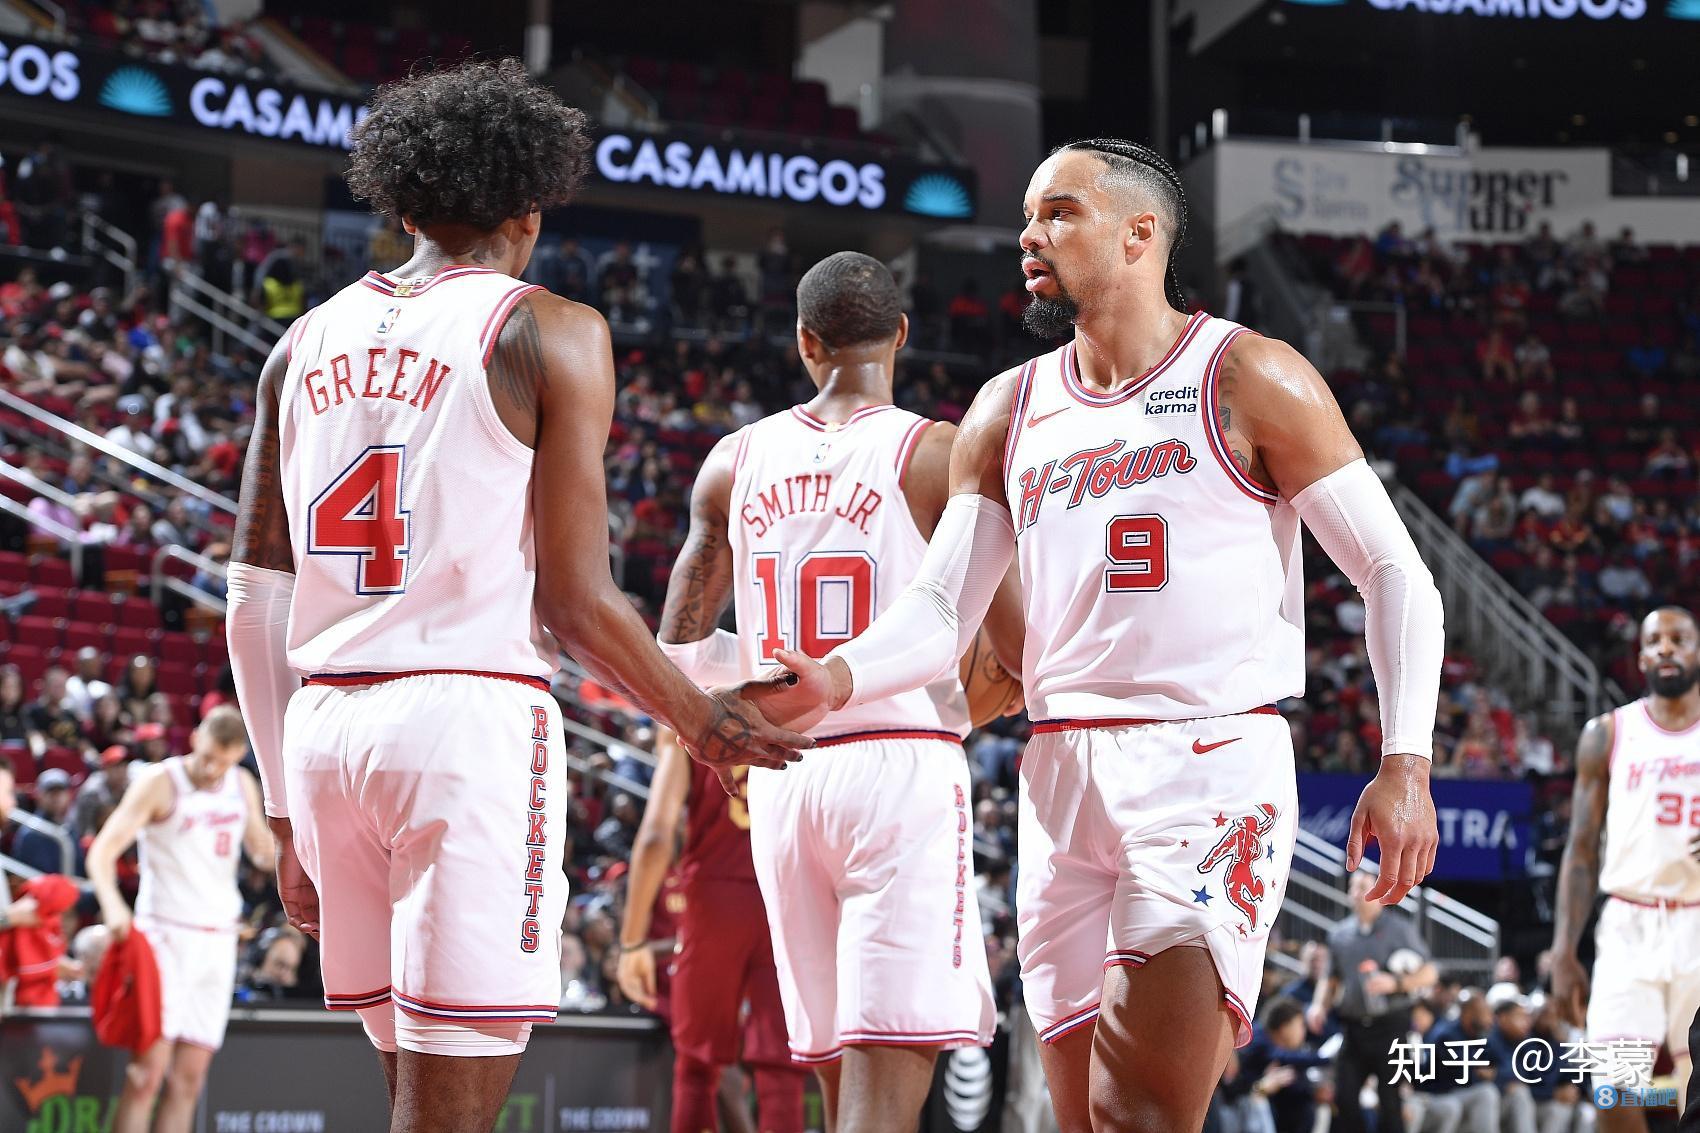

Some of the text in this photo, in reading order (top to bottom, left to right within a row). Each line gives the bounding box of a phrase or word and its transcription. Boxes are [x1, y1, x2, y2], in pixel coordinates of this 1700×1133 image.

[0, 40, 81, 101] OS
[596, 134, 886, 209] CASAMIGOS
[305, 348, 451, 416] GREEN
[1144, 402, 1197, 416] karma
[1149, 386, 1199, 401] credit
[307, 444, 411, 595] 4
[741, 474, 883, 538] SMITH JR.
[1015, 438, 1198, 537] H-Town
[1106, 513, 1169, 593] 9
[752, 550, 877, 666] 10
[520, 705, 549, 953] ROCKETS
